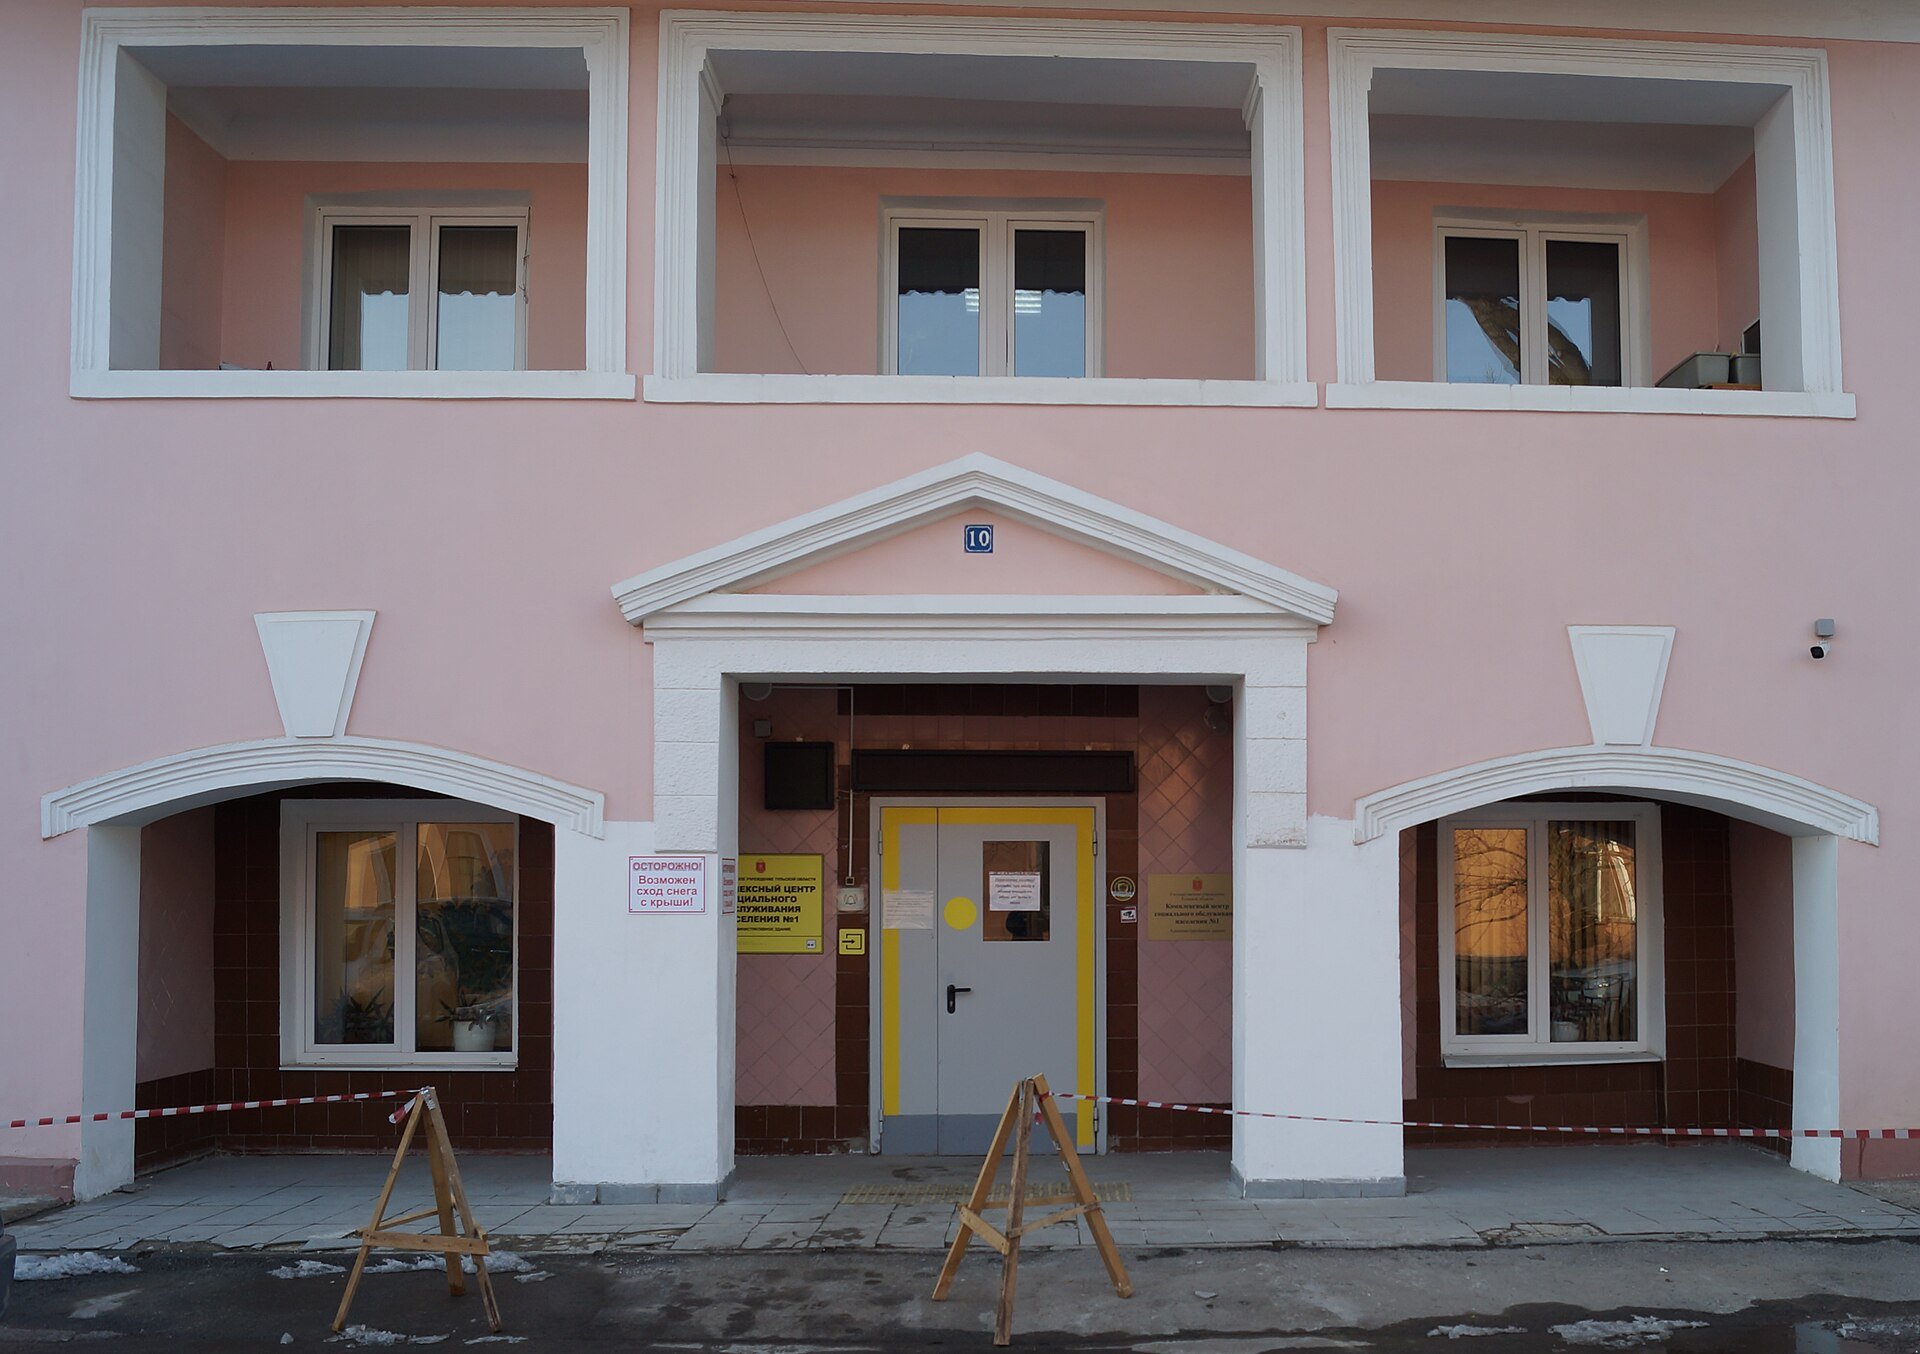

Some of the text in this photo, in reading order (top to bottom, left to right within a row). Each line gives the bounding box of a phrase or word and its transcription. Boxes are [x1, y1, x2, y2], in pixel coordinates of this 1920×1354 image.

[969, 530, 990, 547] 10
[632, 862, 702, 871] ОСТОРОЖНО!
[638, 875, 696, 884] Возможен
[636, 888, 698, 897] сход снега
[784, 885, 816, 894] ЦЕНТР
[650, 897, 693, 908] крыши!
[783, 915, 799, 923] №1
